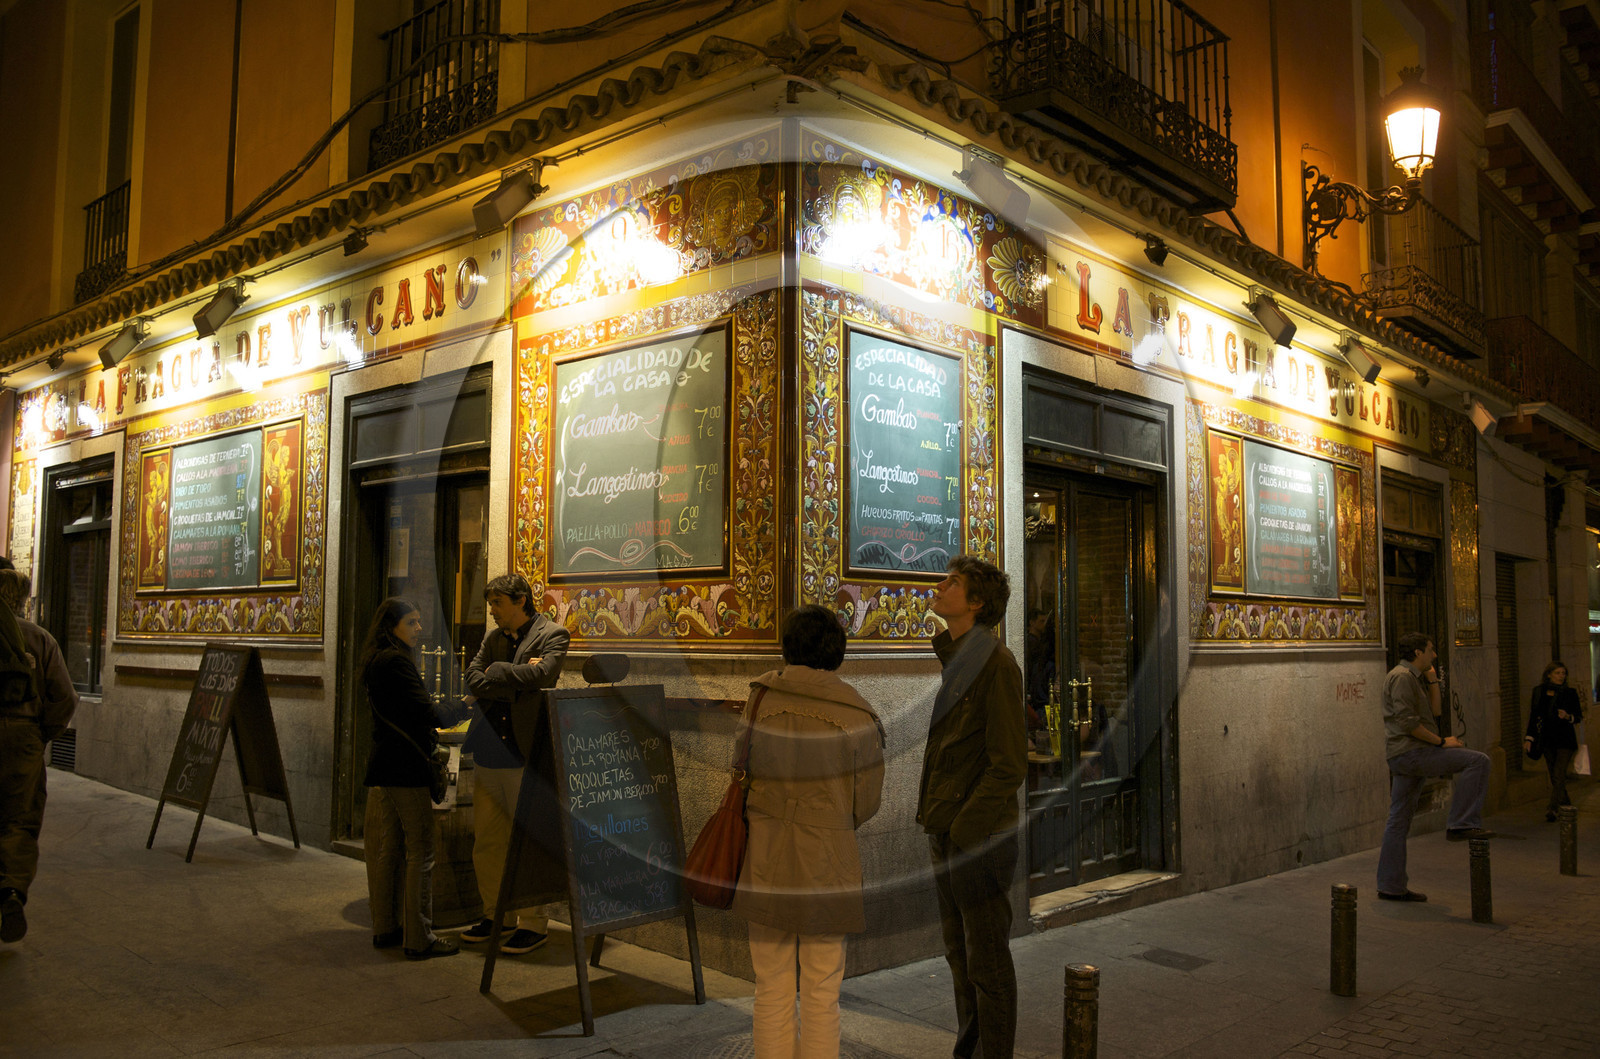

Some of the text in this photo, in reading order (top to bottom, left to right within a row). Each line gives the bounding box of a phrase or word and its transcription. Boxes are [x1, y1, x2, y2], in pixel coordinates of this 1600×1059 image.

[559, 347, 714, 405] ESPECIALIDAD DE
[855, 347, 947, 386] ESPECIALIDAD
[594, 372, 671, 399] LA CASA
[868, 371, 942, 398] DE LA CASA
[570, 403, 638, 440] Gambas
[861, 393, 917, 430] Gambas
[567, 462, 663, 504] Langostinos
[860, 449, 919, 494] Langostinos
[895, 528, 926, 542] CRIOLLO
[206, 651, 238, 674] TODOS
[200, 672, 217, 690] LOS
[185, 720, 221, 751] MIXTA
[567, 729, 630, 755] CALAMARES
[569, 756, 577, 768] A
[580, 754, 596, 767] LA
[596, 746, 640, 769] ROMANA
[568, 767, 635, 793] CROQUETAS
[570, 795, 584, 812] DE
